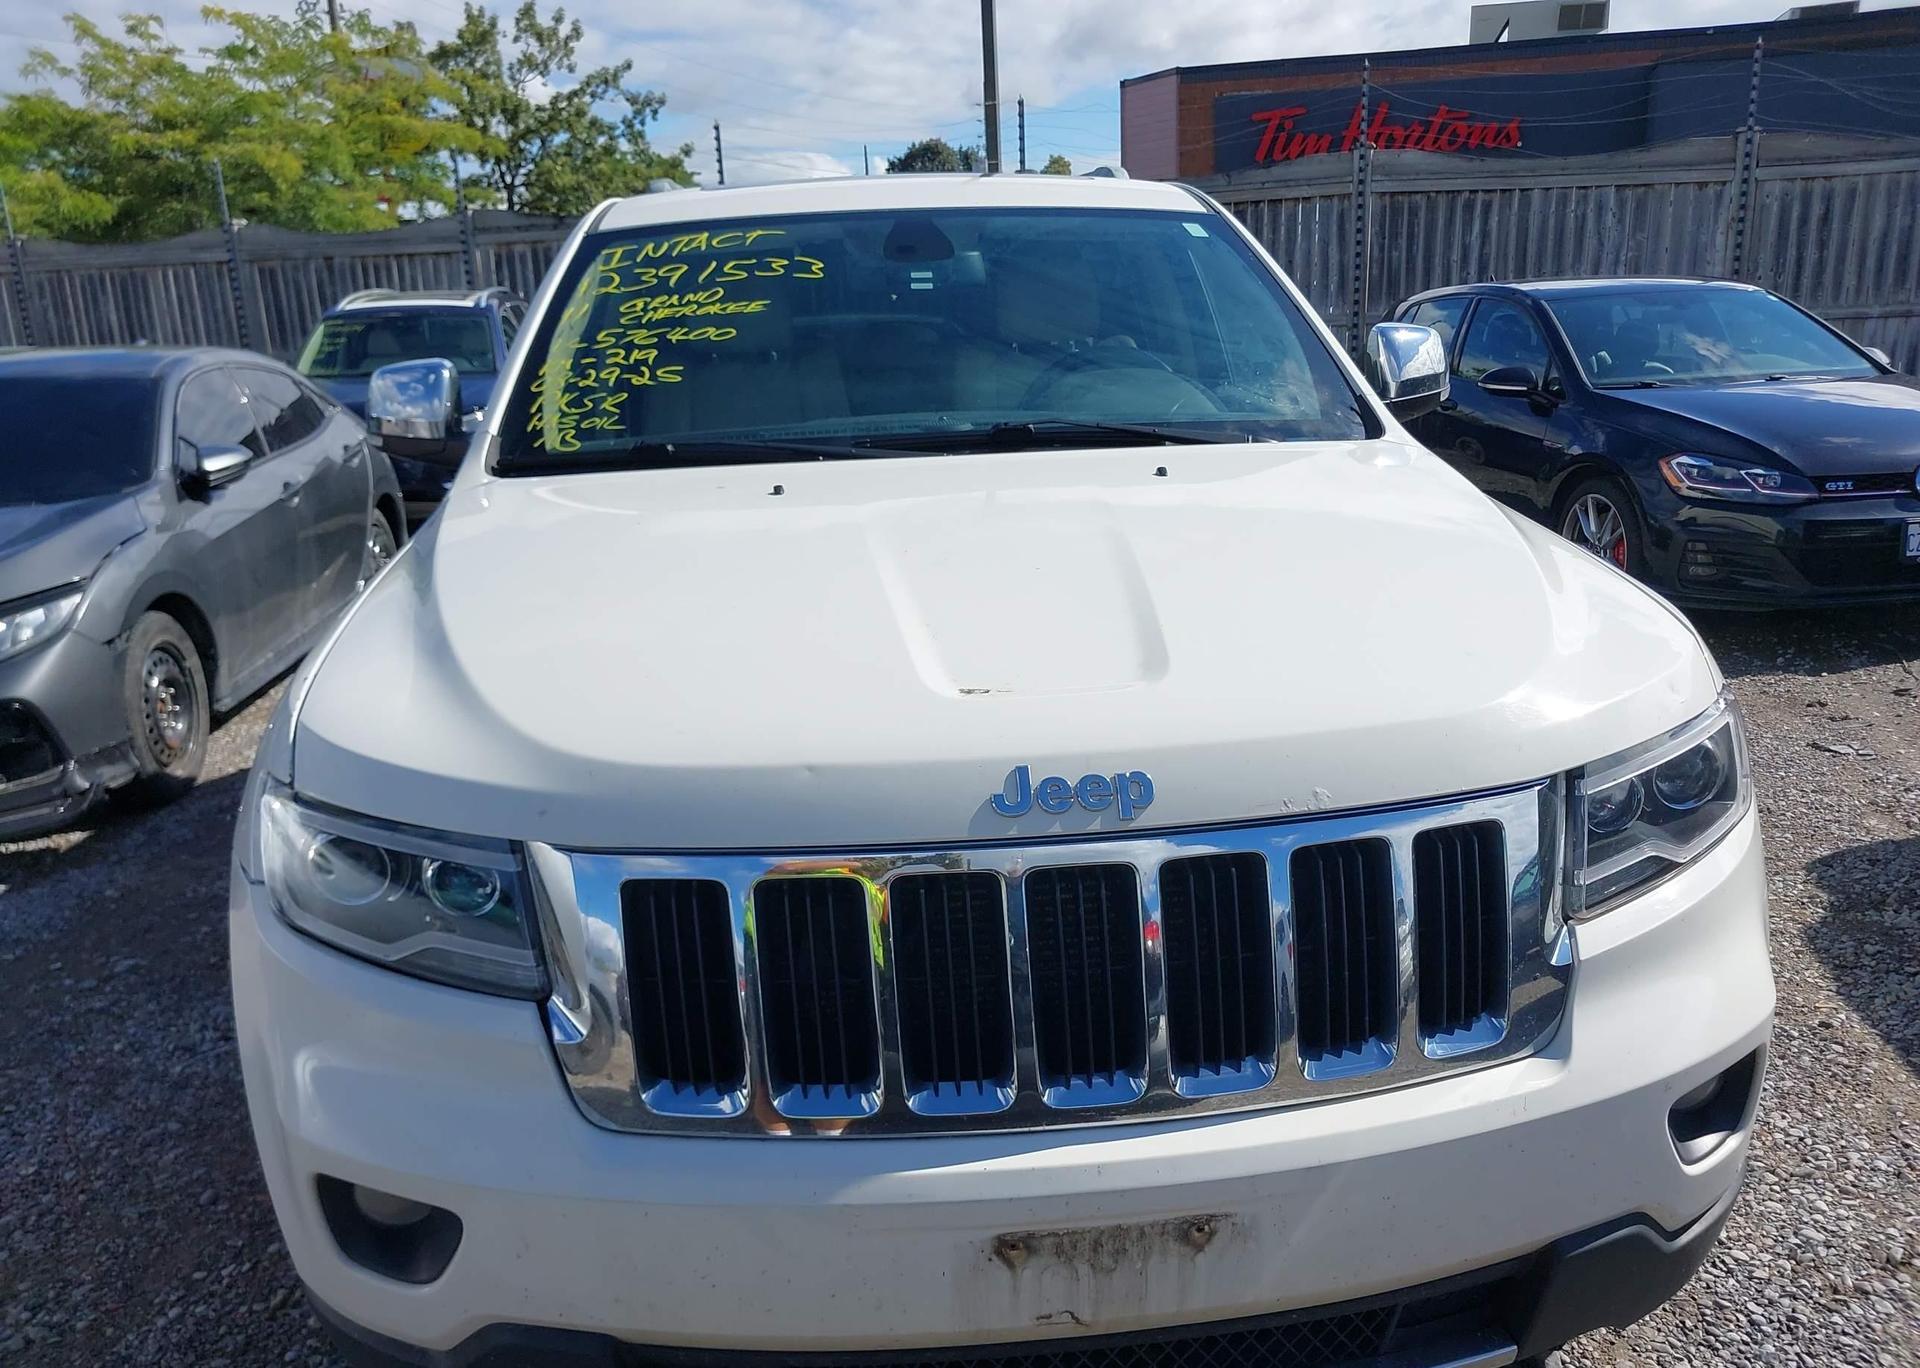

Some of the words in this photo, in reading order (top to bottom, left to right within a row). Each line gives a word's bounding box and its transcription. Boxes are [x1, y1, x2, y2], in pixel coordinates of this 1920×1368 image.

[1251, 106, 1333, 164] Tim
[1341, 101, 1521, 152] Hortons
[600, 230, 787, 271] INTACT
[618, 300, 772, 325] CHEROKEE
[1824, 481, 1855, 491] GTI
[990, 763, 1156, 822] Jeep
